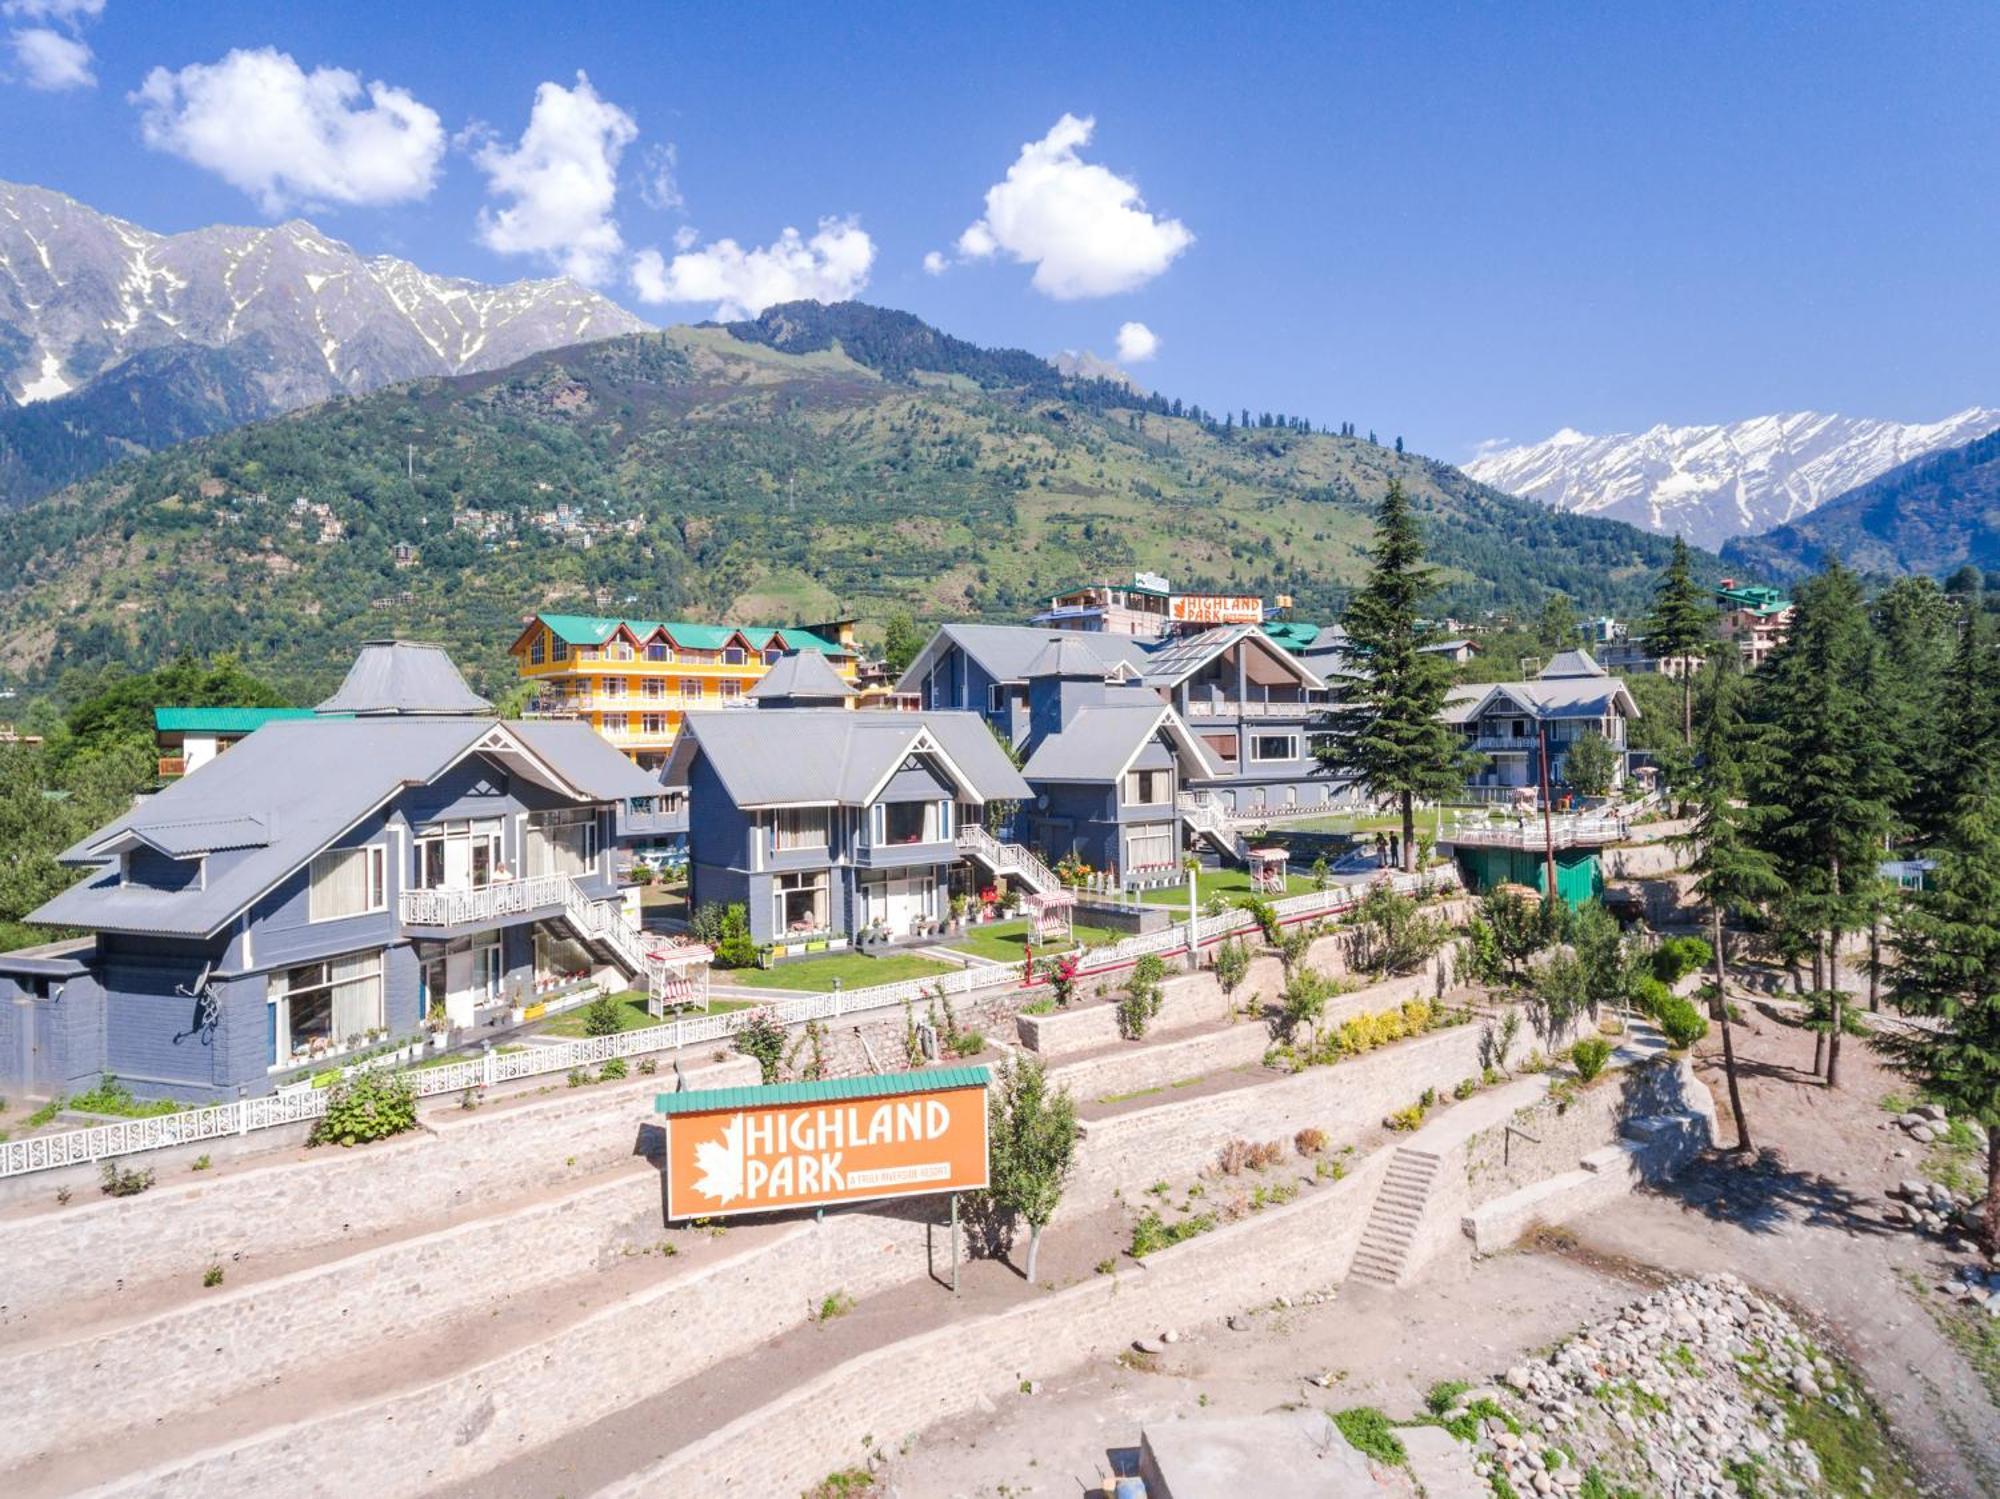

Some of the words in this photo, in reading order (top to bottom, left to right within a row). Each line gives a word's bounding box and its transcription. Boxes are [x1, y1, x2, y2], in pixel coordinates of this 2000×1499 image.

[1188, 598, 1259, 610] HIGHLAND
[1188, 609, 1220, 621] PARK
[747, 1101, 950, 1156] HIGHLAND
[747, 1152, 845, 1200] PARK
